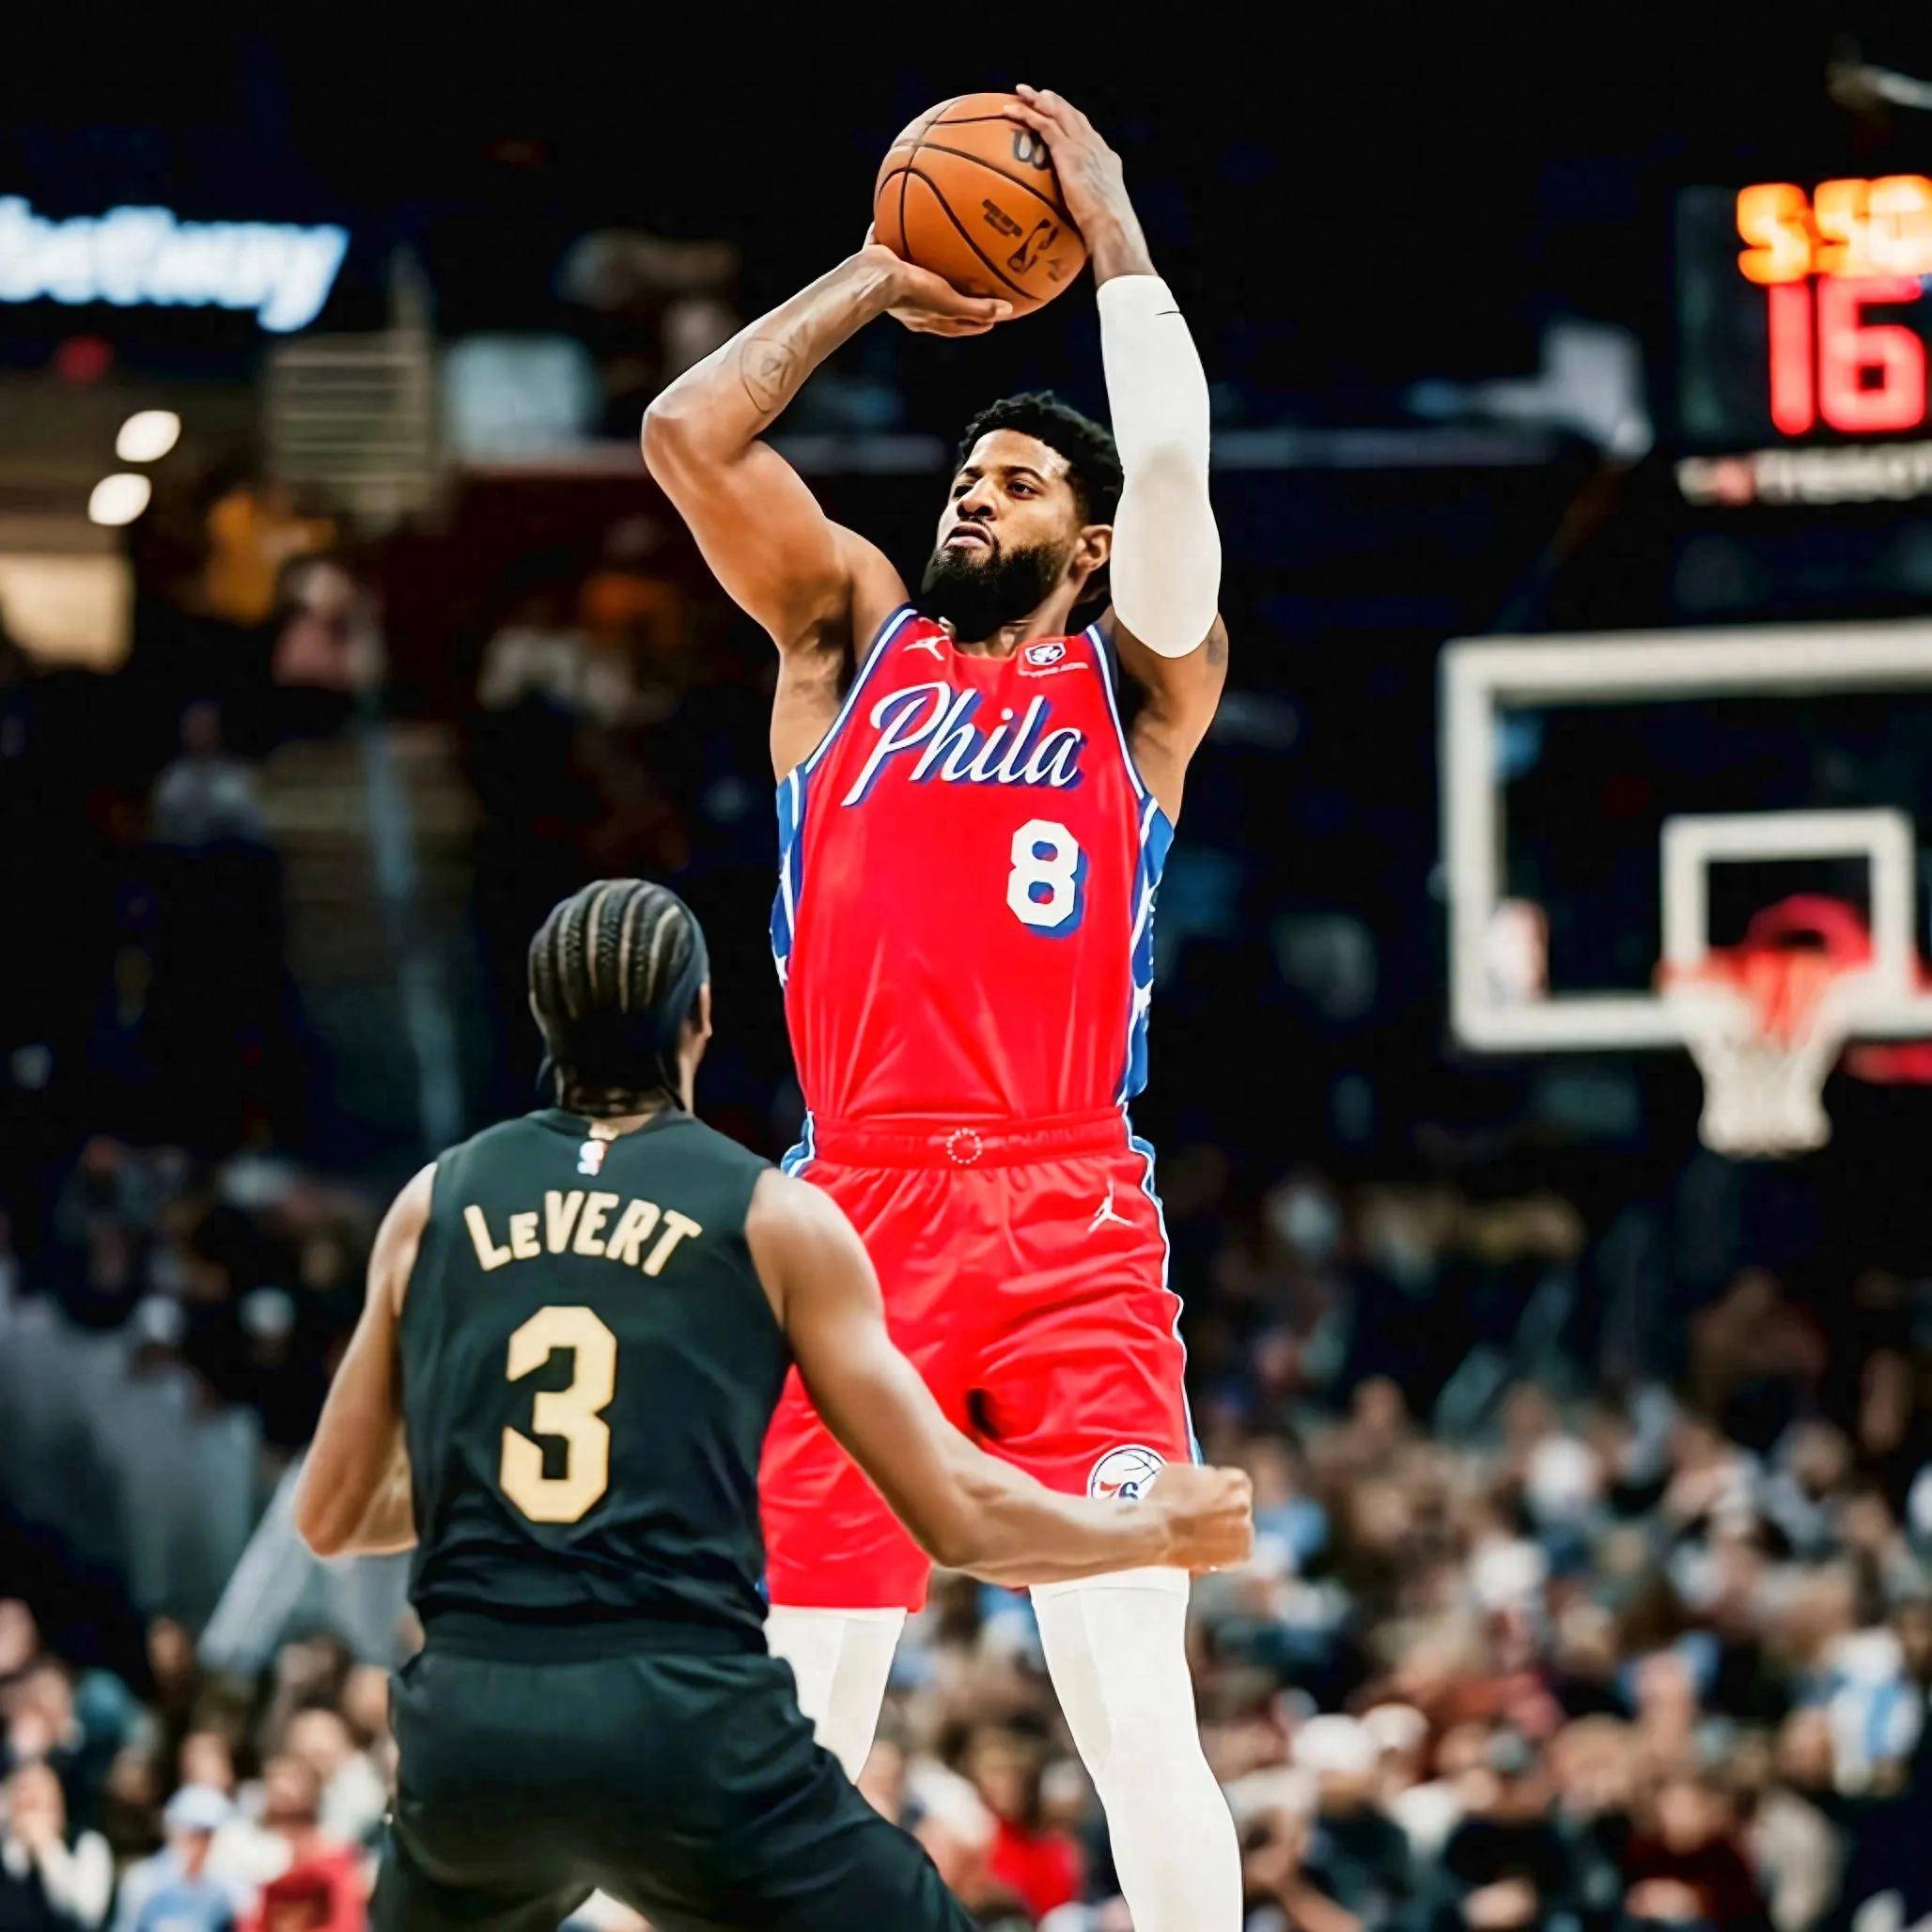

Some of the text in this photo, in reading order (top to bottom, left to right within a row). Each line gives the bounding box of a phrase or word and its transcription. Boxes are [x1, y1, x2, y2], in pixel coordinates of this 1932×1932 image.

[1768, 278, 1925, 435] 16
[839, 680, 1083, 808] Phila
[1005, 818, 1082, 928] 8
[462, 1190, 704, 1278] LeVERT
[500, 1305, 617, 1524] 3
